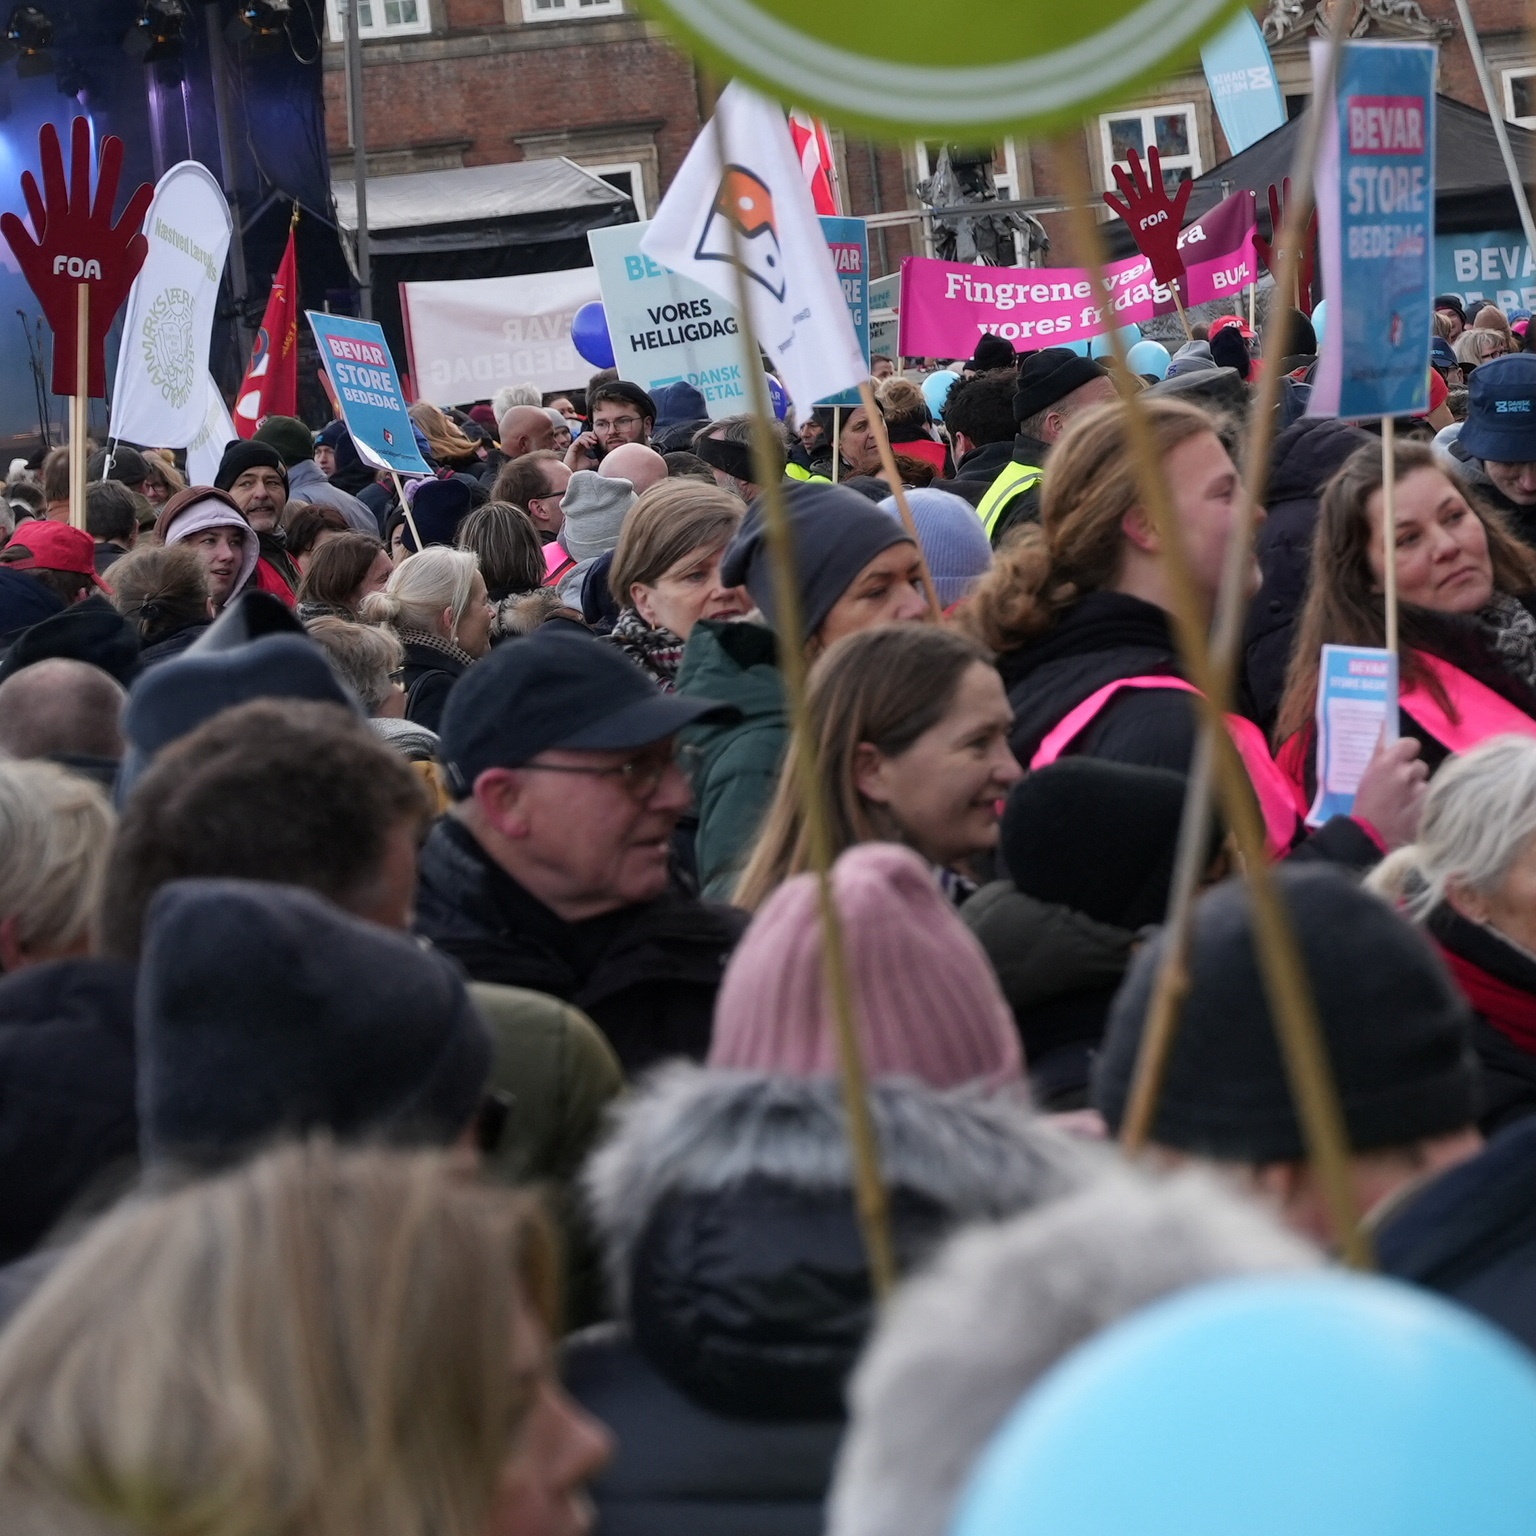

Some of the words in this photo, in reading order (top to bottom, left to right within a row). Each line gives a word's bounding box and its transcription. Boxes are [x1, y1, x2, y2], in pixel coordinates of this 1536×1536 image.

[1350, 105, 1423, 150] BEVAR
[1348, 166, 1425, 215] STORE
[1139, 209, 1168, 231] FOA
[1175, 224, 1207, 251] ra
[53, 254, 102, 280] FOA
[944, 272, 1092, 311] Fingrene
[647, 298, 713, 325] VORES
[629, 316, 739, 352] HELLIGDAG
[977, 314, 1072, 341] vores
[327, 338, 386, 366] BEVAR
[335, 363, 395, 393] STORE
[686, 364, 742, 388] DANSK
[342, 387, 401, 412] BEDEDAG
[703, 380, 744, 402] ETAL
